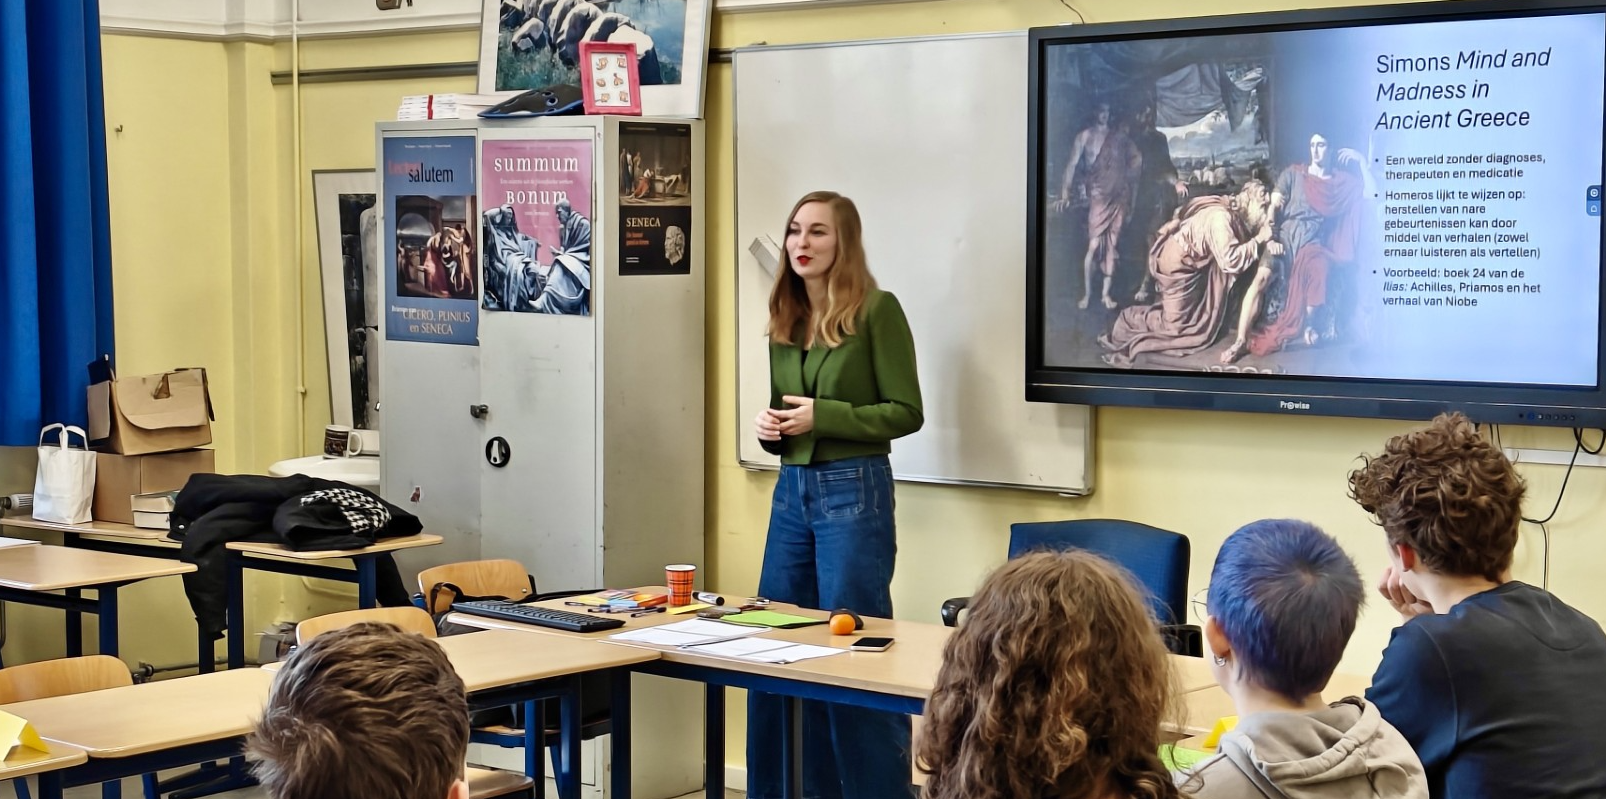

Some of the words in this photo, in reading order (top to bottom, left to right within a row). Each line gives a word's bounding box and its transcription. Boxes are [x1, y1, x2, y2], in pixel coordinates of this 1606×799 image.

[1377, 54, 1450, 73] Simons
[1456, 49, 1507, 69] Mind
[1511, 47, 1552, 67] and
[1376, 82, 1466, 101] Madness
[1472, 80, 1489, 98] in
[1375, 110, 1451, 130] Ancient
[1457, 108, 1530, 128] Greece
[494, 156, 579, 172] summum
[1386, 156, 1405, 165] Een
[1408, 155, 1443, 164] wereld
[1447, 154, 1482, 164] zonder
[1486, 153, 1545, 165] diagnoses,
[408, 162, 454, 182] salutem
[1386, 170, 1449, 181] therapeuten
[1453, 170, 1465, 178] en
[1469, 168, 1523, 178] medicatie
[1386, 191, 1433, 200] Homeros
[1436, 190, 1455, 202] lijkt
[1459, 191, 1468, 199] te
[1472, 189, 1505, 201] wijzen
[1508, 191, 1525, 201] op:
[1385, 205, 1437, 214] herstellen
[1440, 206, 1458, 214] van
[1462, 206, 1485, 214] nare
[626, 218, 660, 227] SENECA
[1384, 219, 1466, 230] gebeurtenissen
[1470, 218, 1488, 228] kan
[1492, 218, 1517, 228] door
[1384, 233, 1420, 243] middel
[1423, 234, 1441, 242] van
[1445, 232, 1491, 242] verhalen
[1494, 232, 1529, 244] (zowel
[1384, 249, 1418, 257] ernaar
[1421, 247, 1467, 257] luisteren
[1470, 247, 1486, 257] als
[1489, 248, 1540, 259] vertellen)
[1383, 268, 1440, 278] Voorbeeld:
[1444, 268, 1469, 278] boek
[1473, 268, 1485, 278] 24
[1488, 270, 1507, 278] van
[1511, 268, 1524, 278] de
[1383, 282, 1407, 291] Ilias:
[1411, 281, 1456, 293] Achilles,
[1459, 282, 1503, 293] Priamos
[1507, 285, 1520, 293] en
[1523, 283, 1541, 293] het
[1383, 296, 1421, 306] verhaal
[1424, 298, 1442, 306] van
[1446, 296, 1477, 306] Niobe
[438, 311, 470, 322] PLINIUS
[422, 324, 453, 334] SENECA
